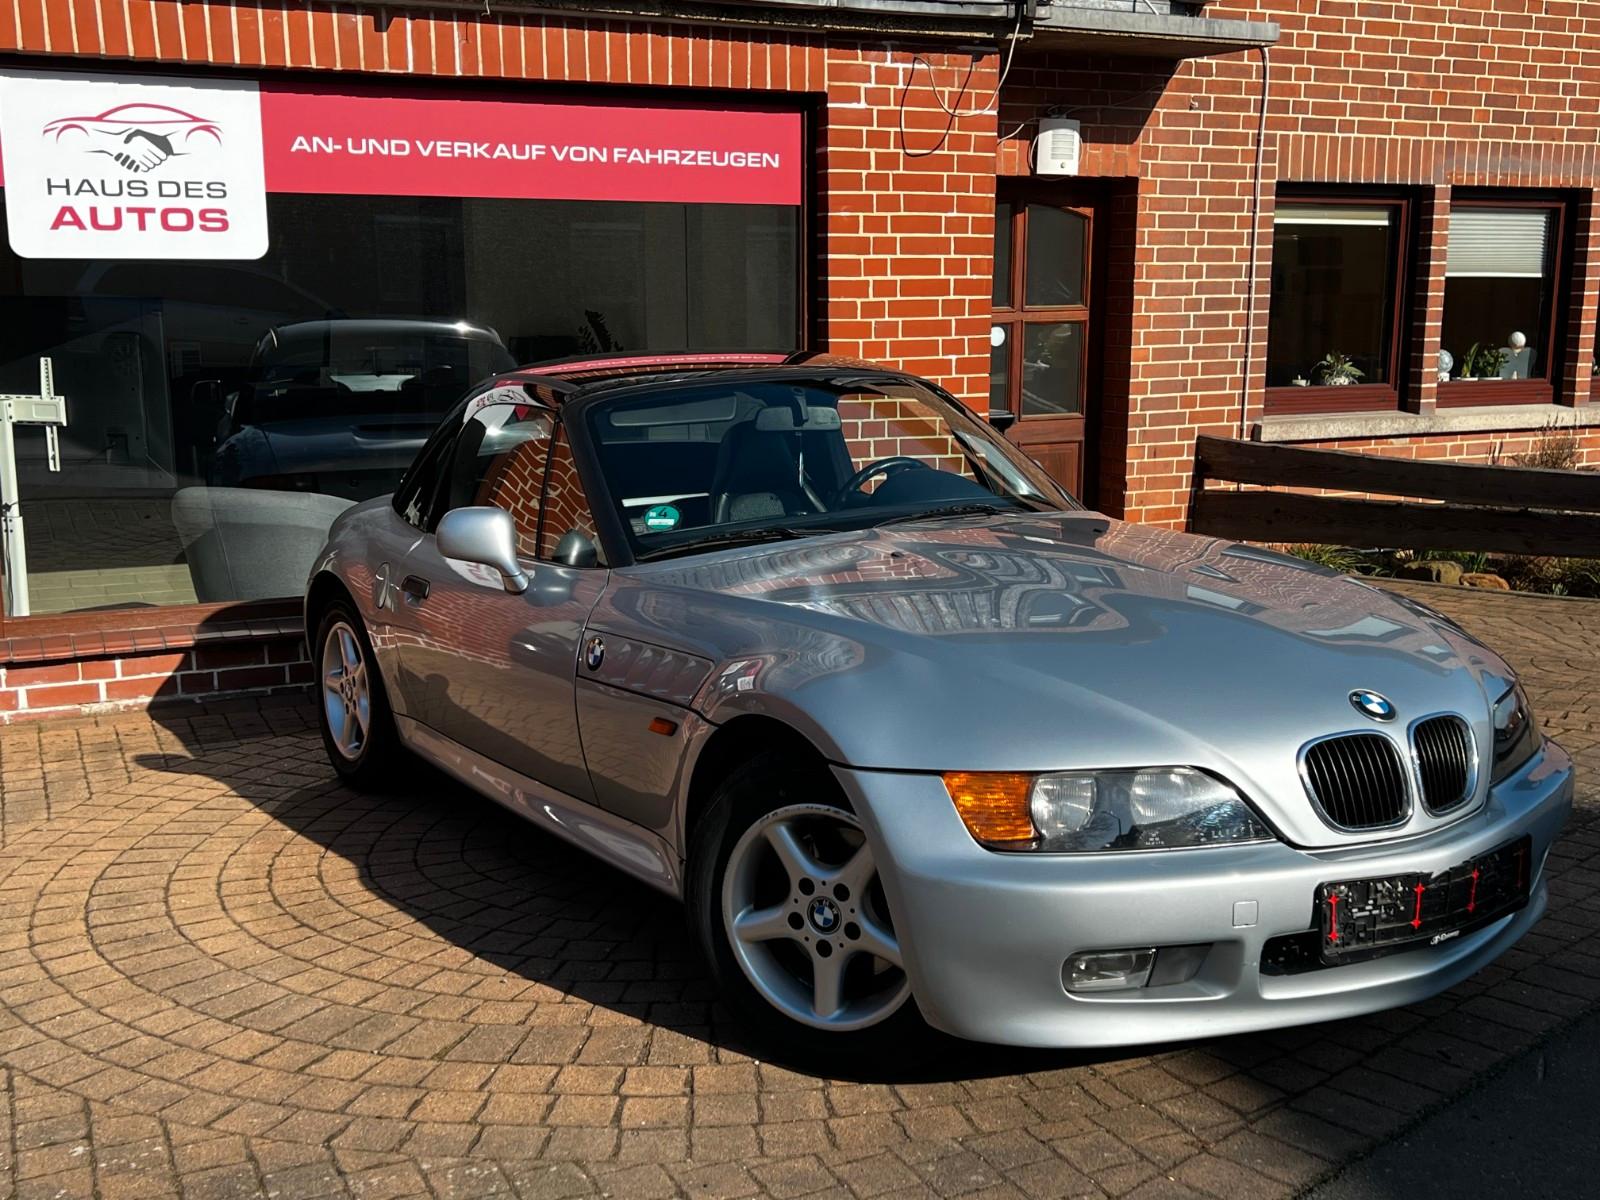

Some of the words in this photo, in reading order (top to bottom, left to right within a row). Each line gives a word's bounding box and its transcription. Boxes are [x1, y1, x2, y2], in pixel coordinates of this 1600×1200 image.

[290, 135, 343, 154] AN-
[347, 137, 411, 156] UND
[415, 140, 546, 161] VERKAUF
[550, 145, 608, 163] VON
[613, 147, 780, 168] FAHRZEUGEN
[46, 177, 149, 198] HAUS
[157, 180, 227, 199] DES
[49, 205, 230, 233] AUTOS
[657, 507, 667, 518] 4
